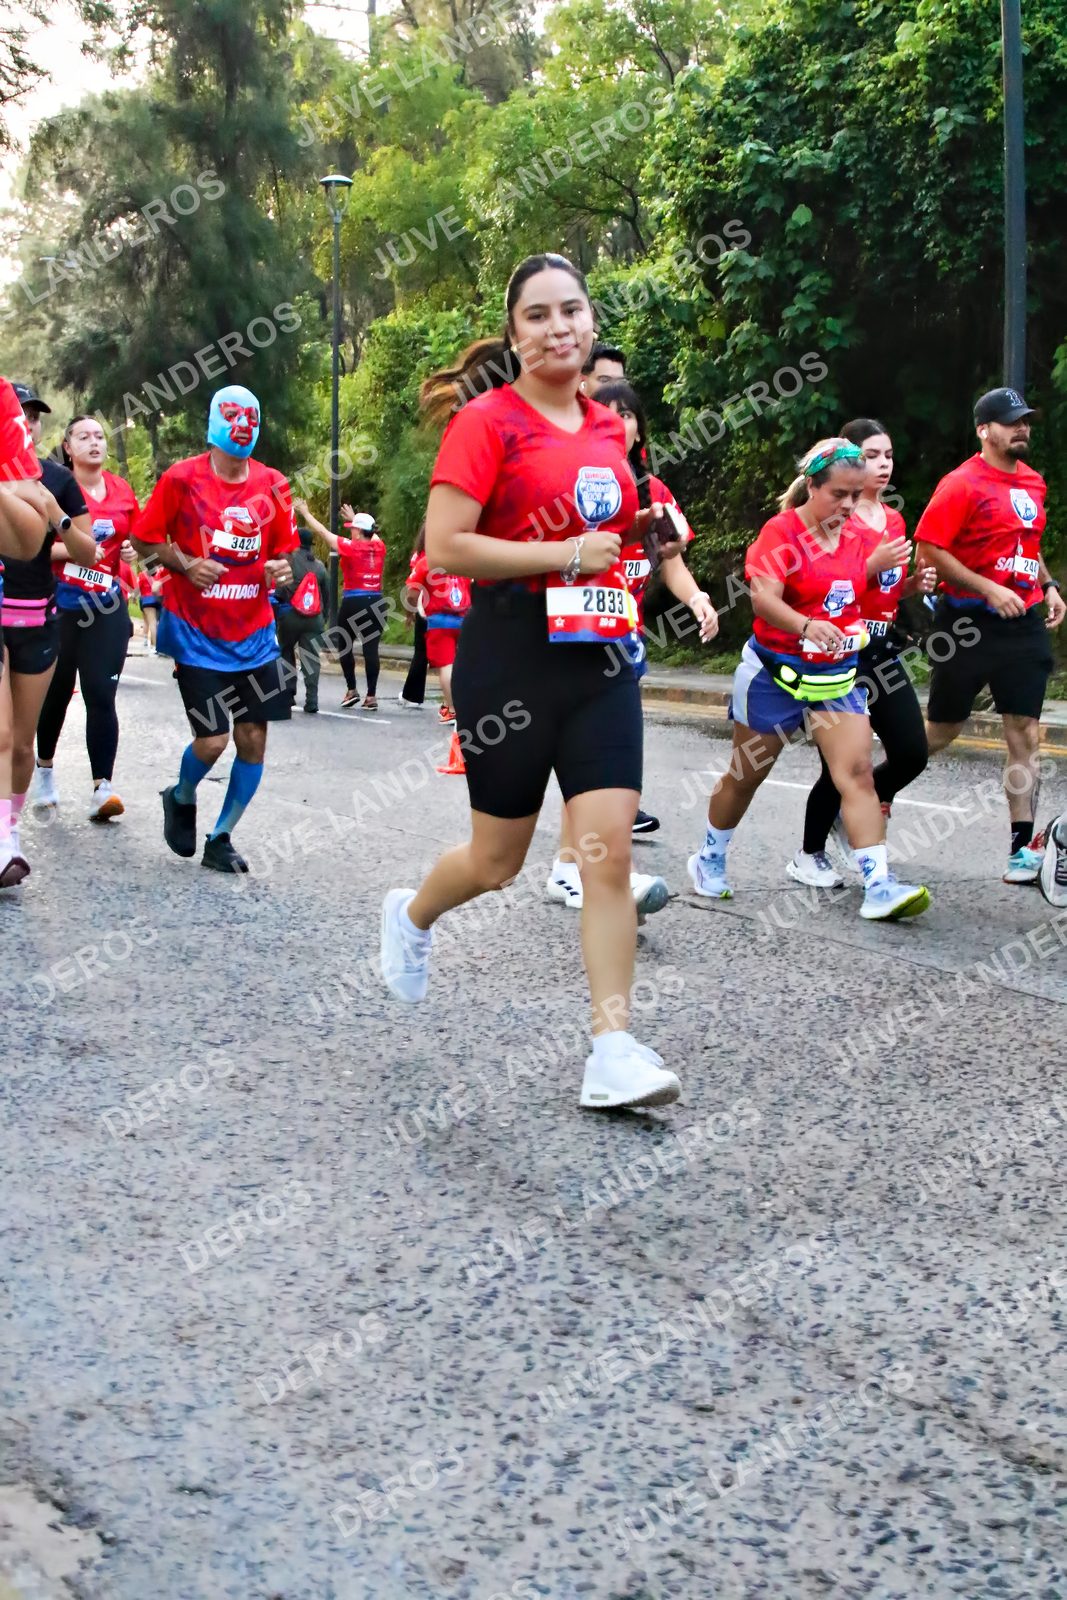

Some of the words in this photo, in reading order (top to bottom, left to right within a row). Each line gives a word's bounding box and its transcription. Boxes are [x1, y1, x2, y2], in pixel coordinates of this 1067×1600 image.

[231, 536, 257, 550] 3422
[78, 567, 105, 584] 17608
[201, 583, 260, 600] SANTIAGO
[582, 588, 624, 615] 2833
